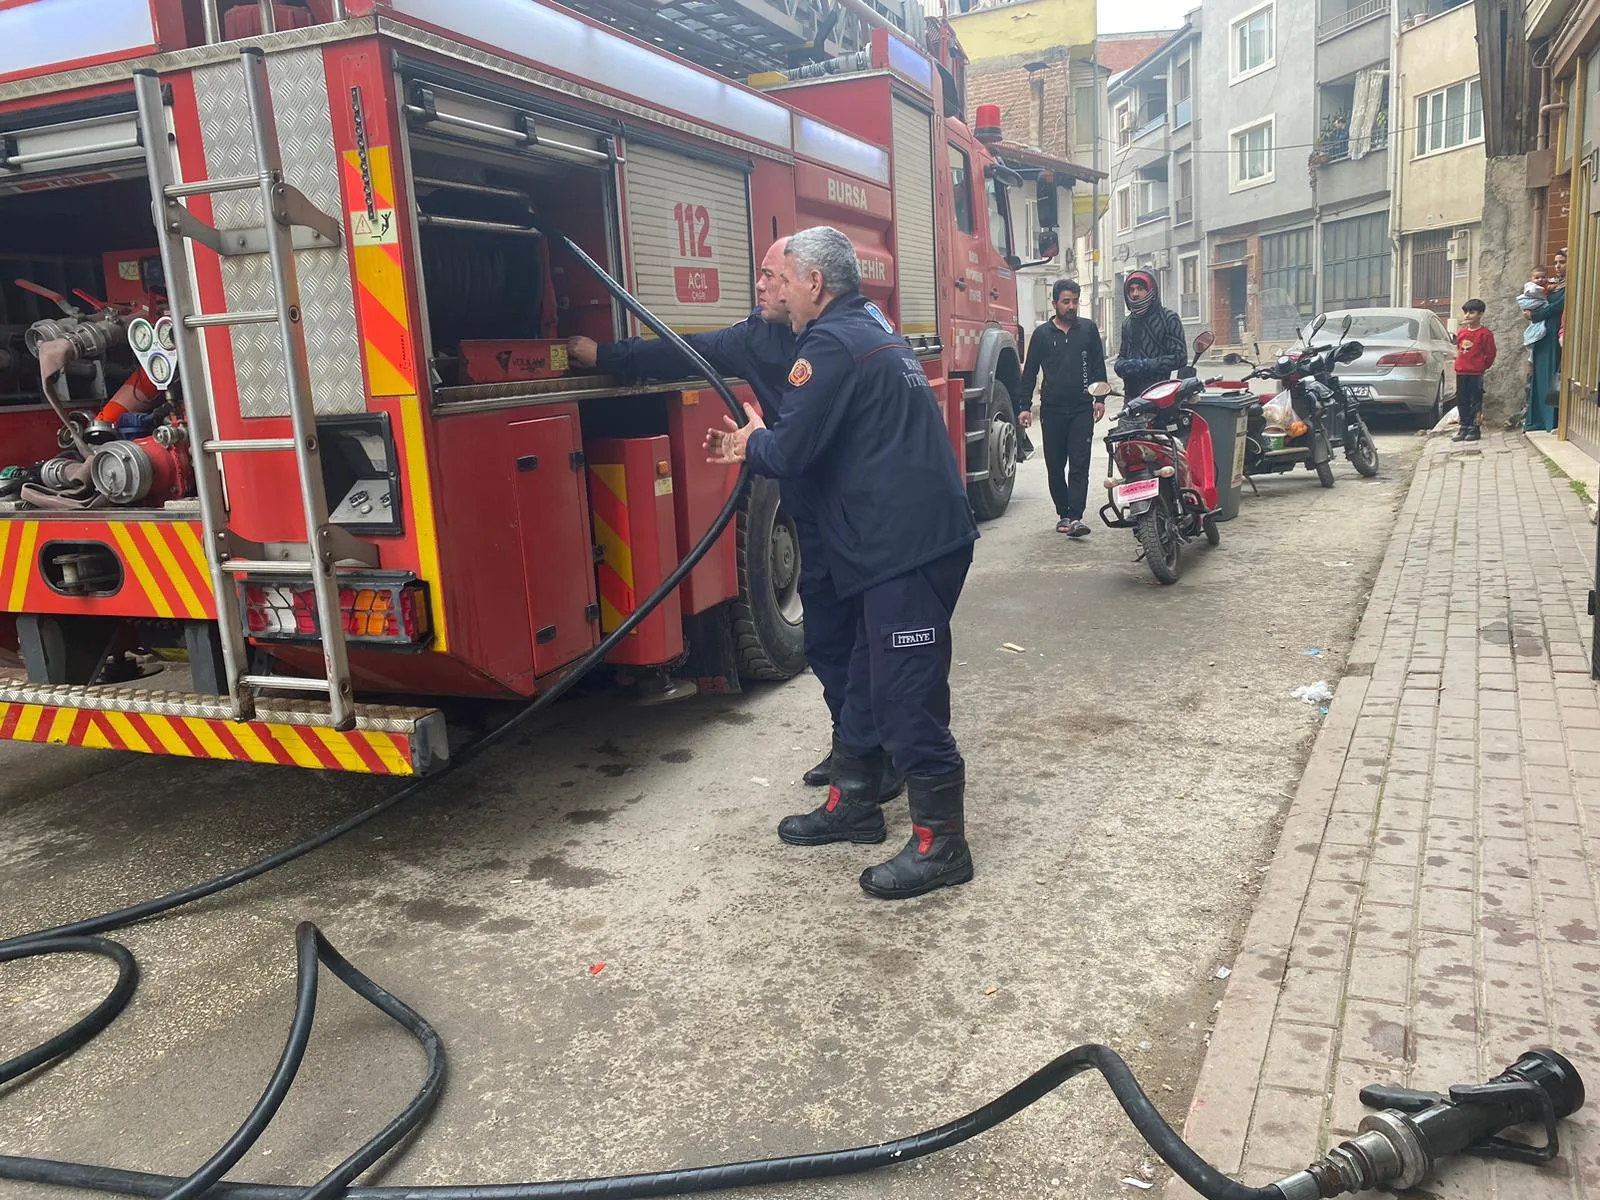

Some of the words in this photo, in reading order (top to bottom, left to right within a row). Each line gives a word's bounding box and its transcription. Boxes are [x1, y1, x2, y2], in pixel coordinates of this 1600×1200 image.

[827, 178, 868, 210] BURSA
[674, 201, 713, 258] 112
[898, 633, 931, 644] İTFAİYE
